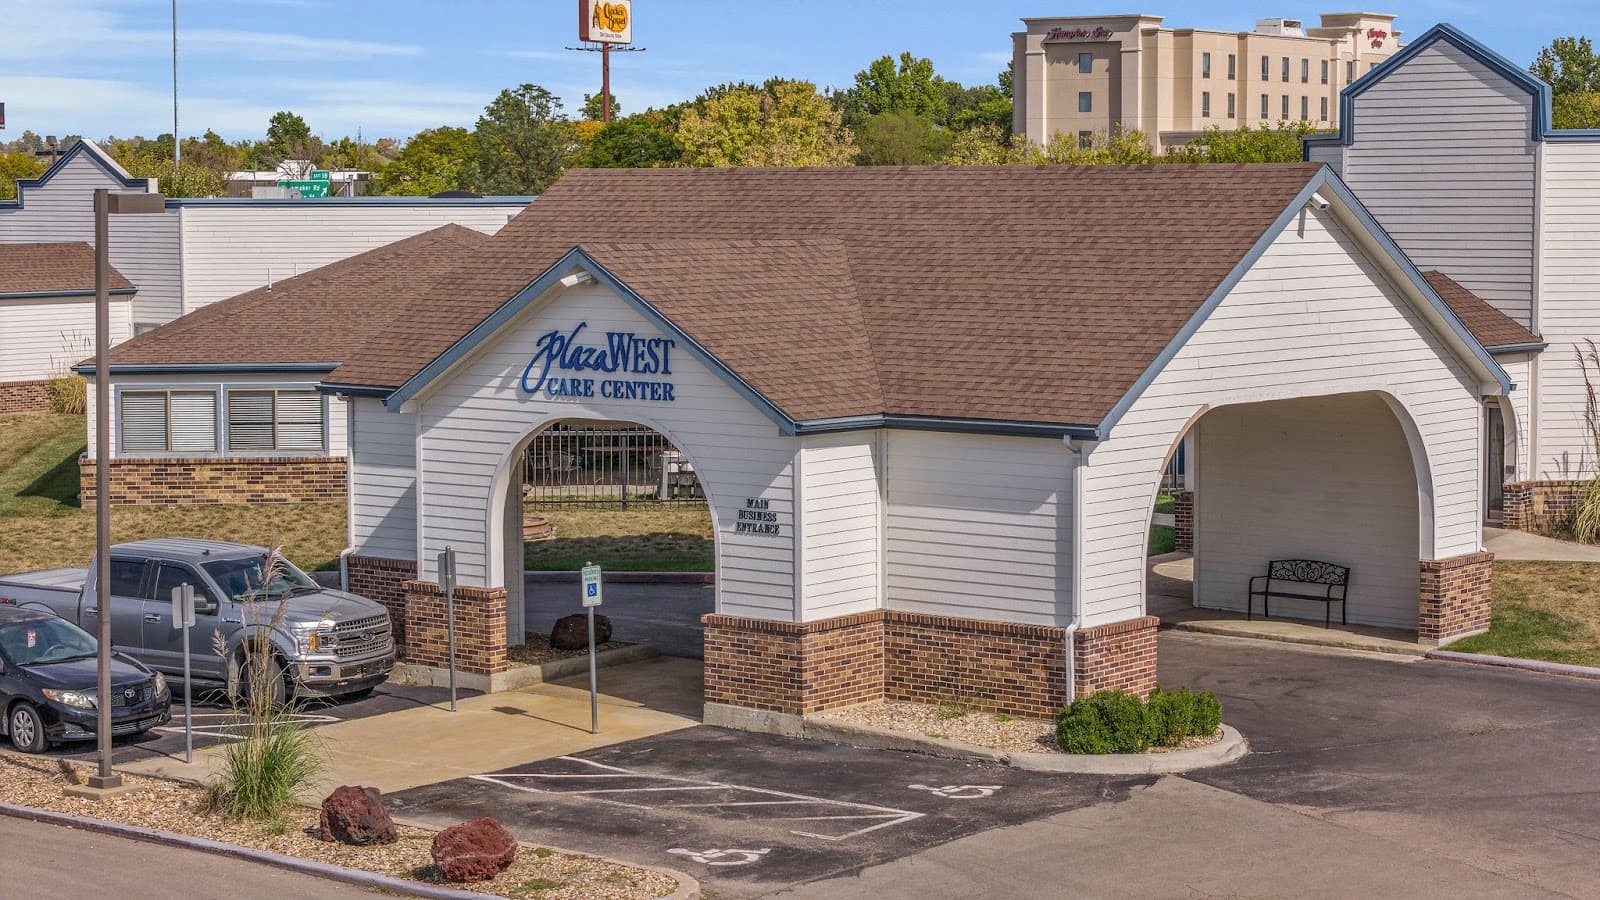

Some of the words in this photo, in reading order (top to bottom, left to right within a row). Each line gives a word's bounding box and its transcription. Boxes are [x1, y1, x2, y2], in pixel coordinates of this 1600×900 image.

[546, 377, 595, 397] CARE
[601, 379, 675, 401] CENTER
[746, 498, 769, 509] MAIN
[738, 509, 777, 522] BUSINESS
[736, 521, 780, 534] ENTRANCE
